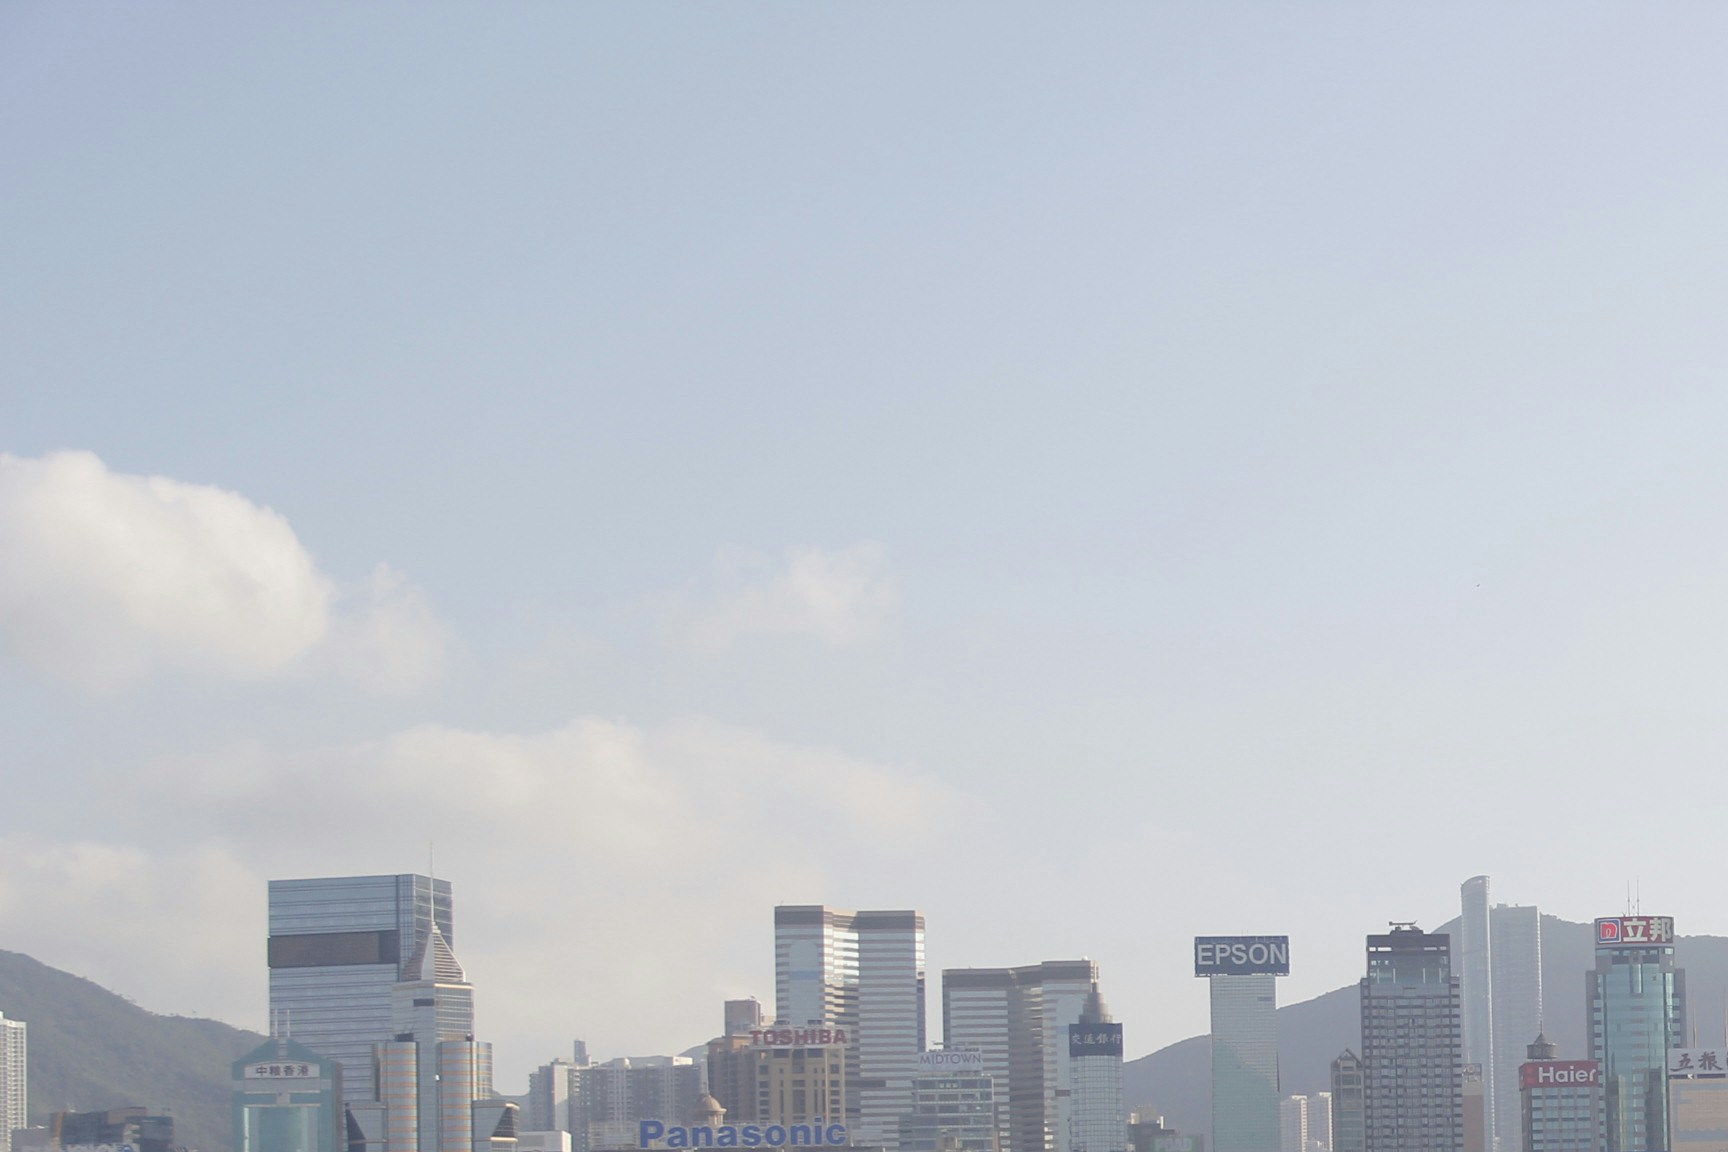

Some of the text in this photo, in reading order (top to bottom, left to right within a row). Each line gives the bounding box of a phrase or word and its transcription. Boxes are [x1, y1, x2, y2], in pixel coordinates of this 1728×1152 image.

[1623, 918, 1672, 942] 立邦
[1197, 943, 1287, 966] EPSON
[749, 1029, 848, 1045] TOSHIBA
[919, 1053, 982, 1065] MIDTOWN
[1538, 1065, 1597, 1083] Haier
[640, 1116, 846, 1149] Panasonic
